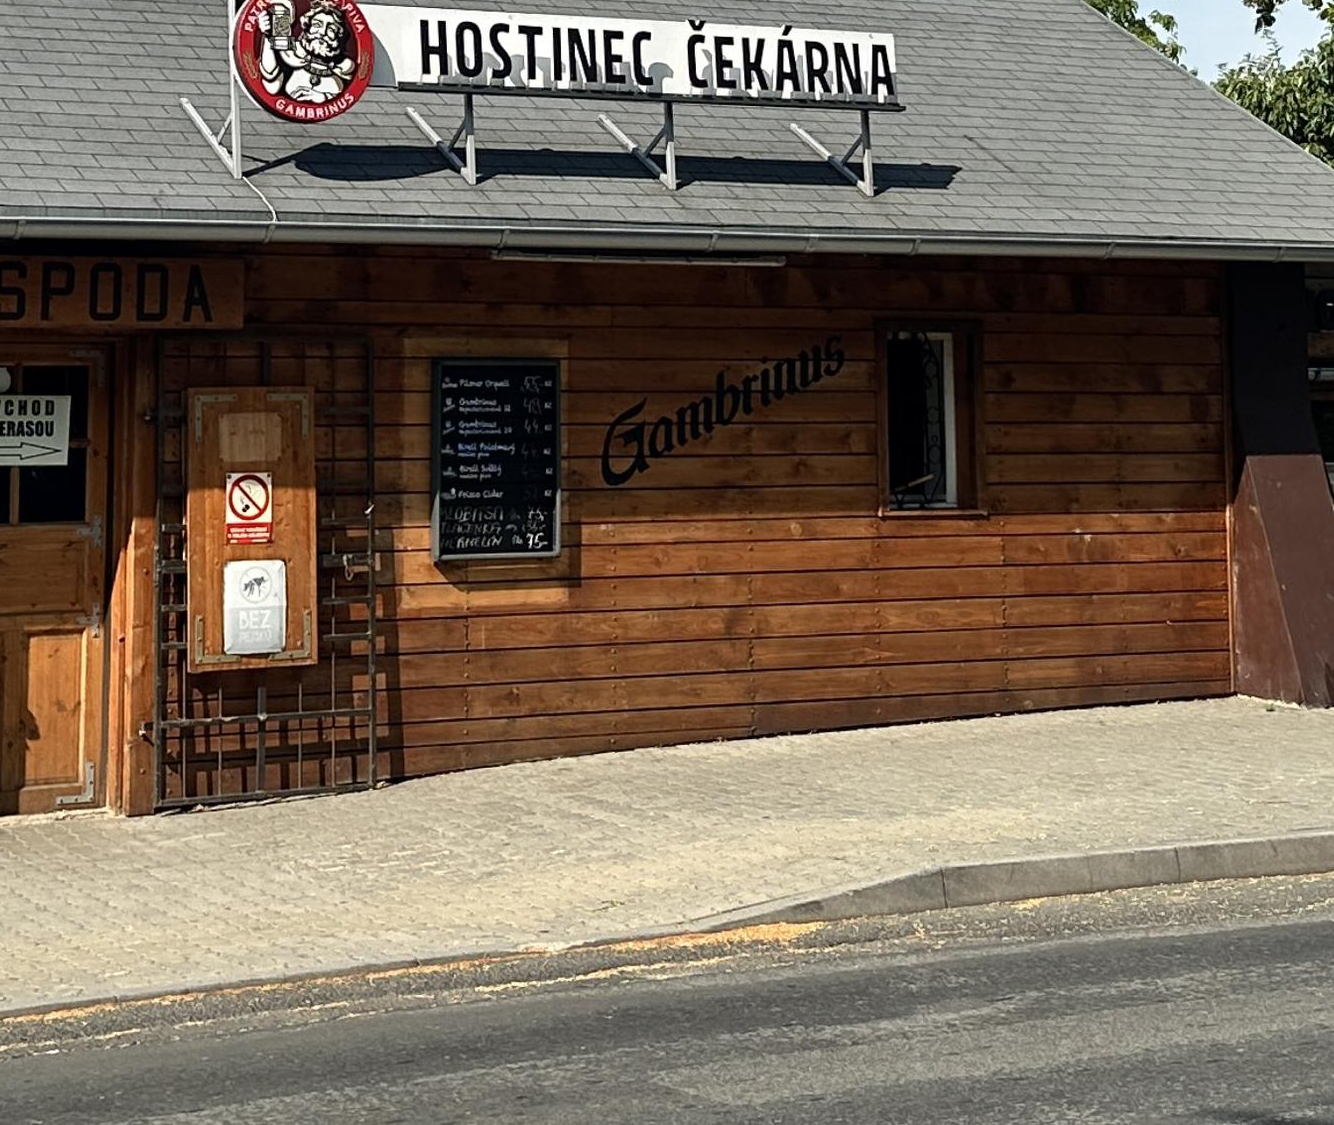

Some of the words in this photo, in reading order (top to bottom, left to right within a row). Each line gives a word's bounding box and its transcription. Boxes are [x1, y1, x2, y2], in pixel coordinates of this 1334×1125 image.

[346, 5, 367, 33] PIVA
[419, 19, 653, 87] HOSTINEC
[686, 19, 893, 96] ČEKÁRNA
[275, 93, 355, 119] GAMBRINUS
[601, 335, 845, 486] Gambrinus
[239, 610, 272, 630] BEZ
